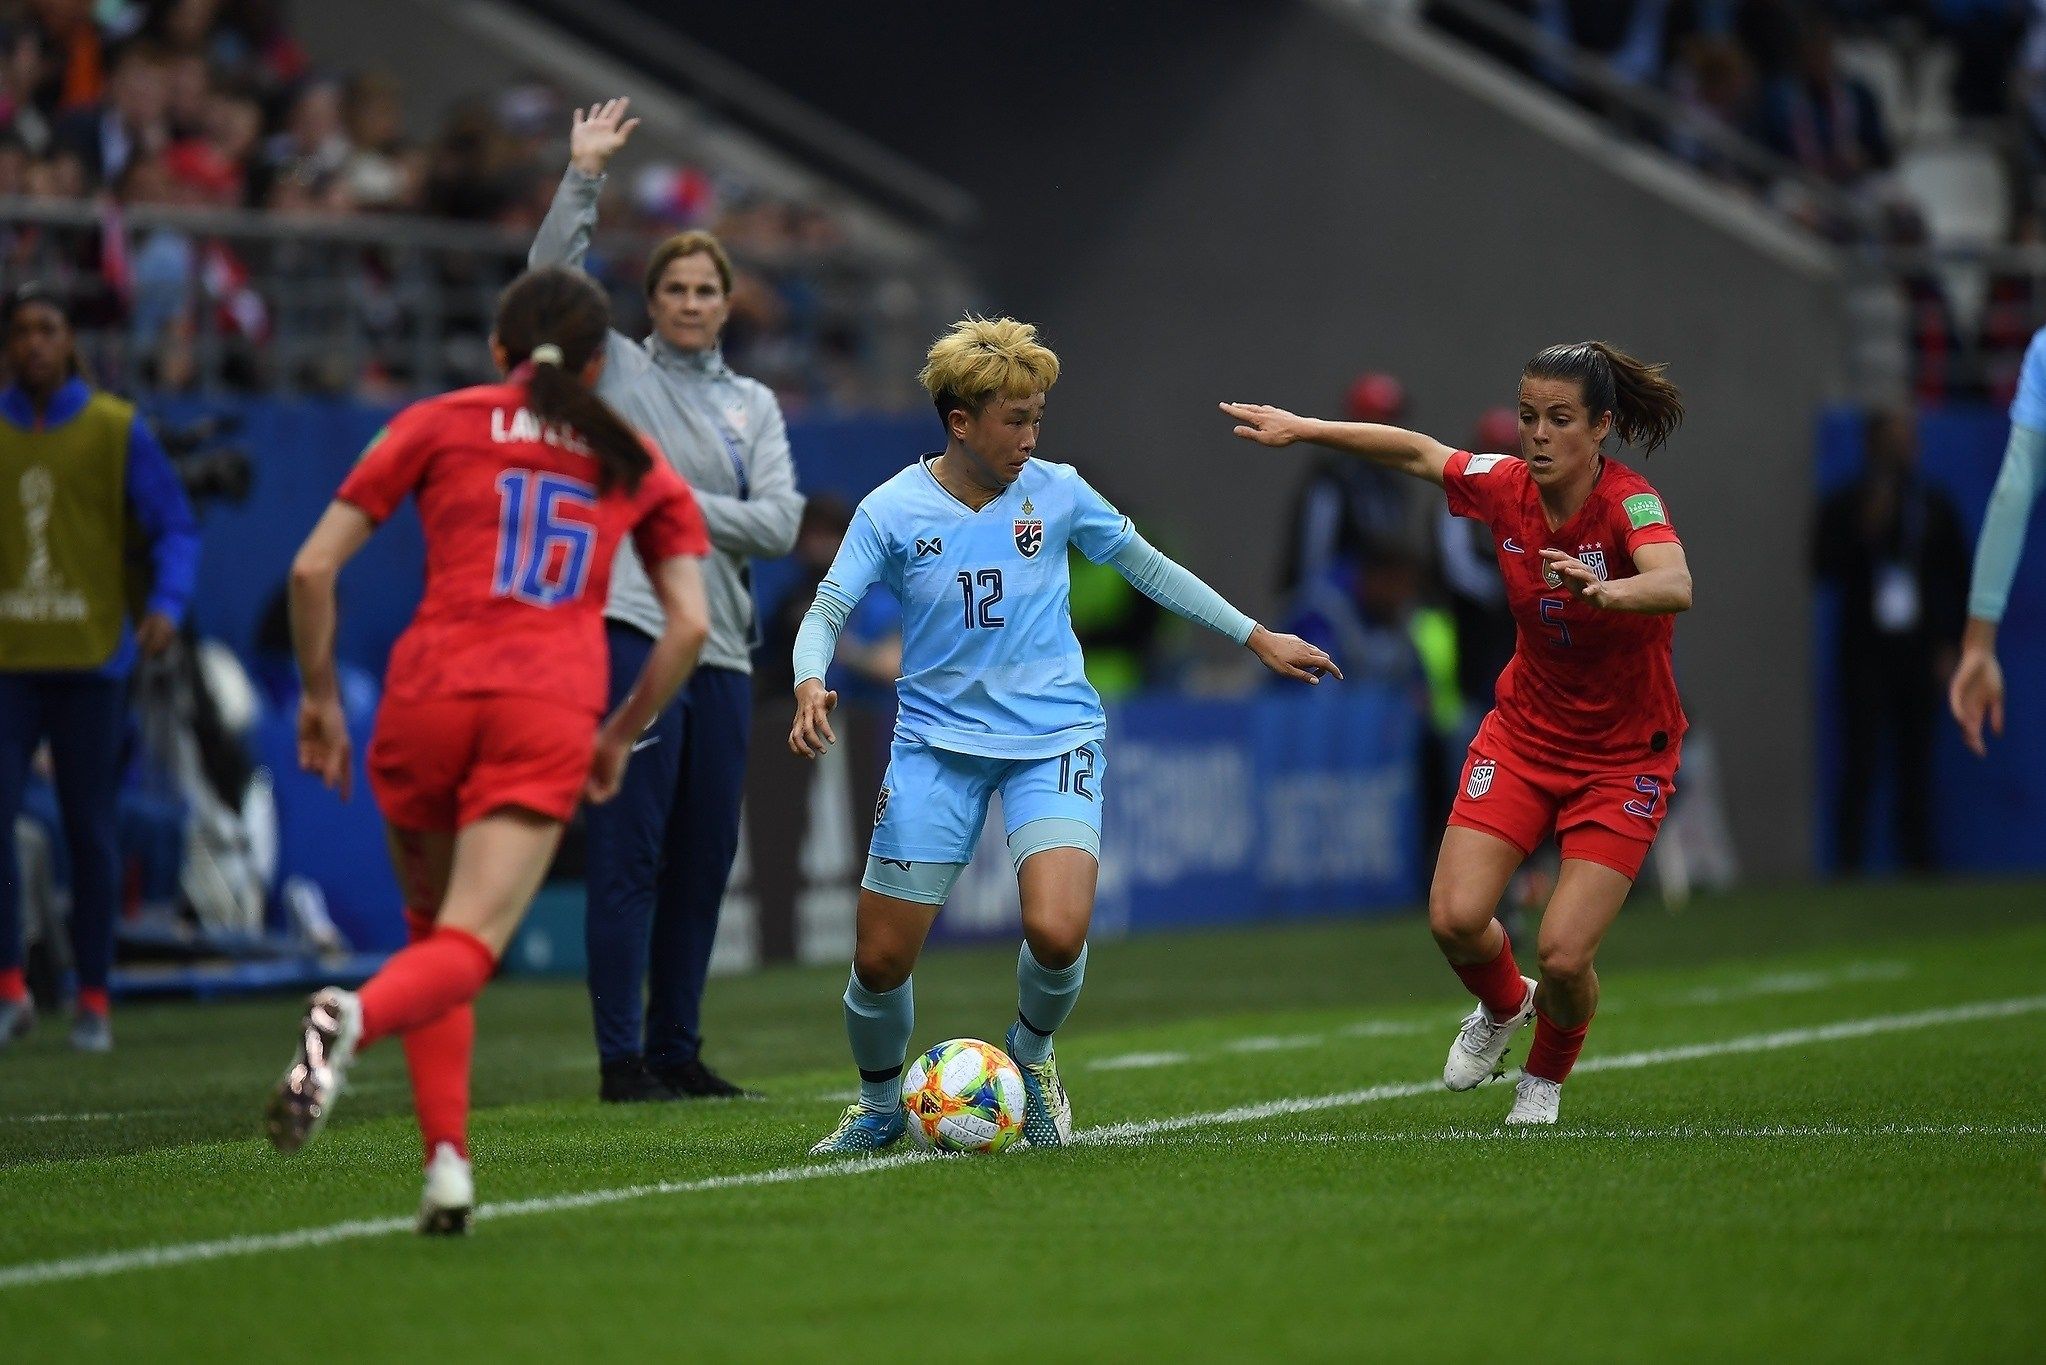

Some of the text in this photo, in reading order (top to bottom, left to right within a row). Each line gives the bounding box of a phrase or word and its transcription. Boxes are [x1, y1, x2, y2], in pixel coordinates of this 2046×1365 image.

[490, 467, 599, 610] 16
[1580, 552, 1602, 568] USA
[957, 568, 1005, 630] 12
[1540, 598, 1572, 648] 5
[1058, 746, 1095, 803] 12
[1472, 767, 1493, 780] USA
[1623, 775, 1661, 819] 5
